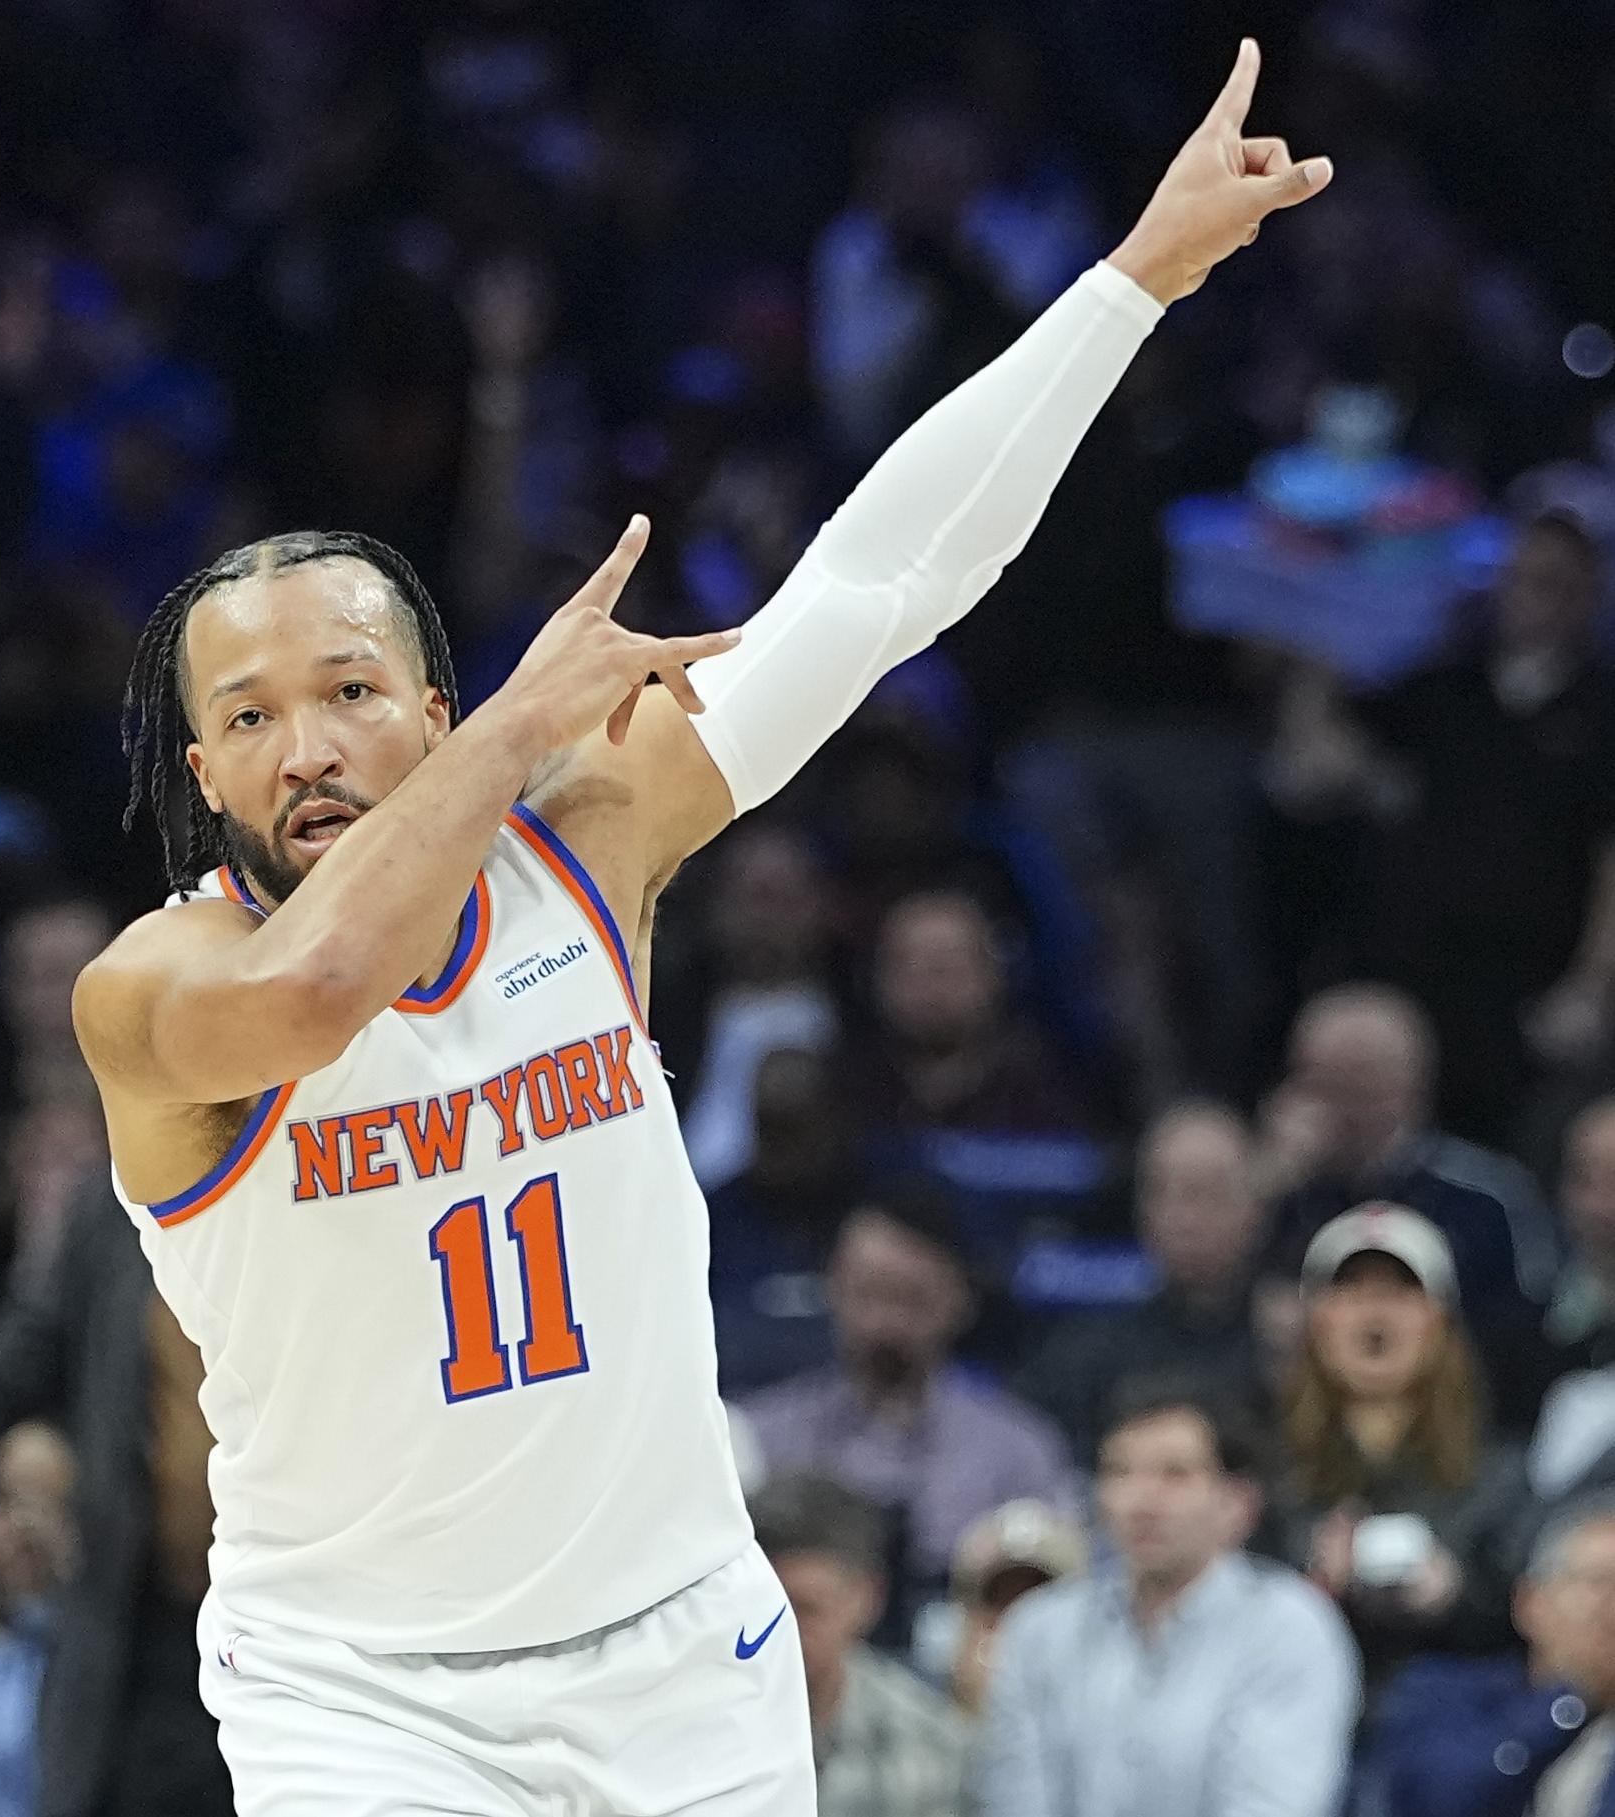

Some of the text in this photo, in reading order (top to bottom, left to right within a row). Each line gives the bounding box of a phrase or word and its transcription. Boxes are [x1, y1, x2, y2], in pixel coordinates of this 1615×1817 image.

[495, 952, 542, 983] experience
[503, 936, 588, 999] abu dhabi
[287, 1023, 645, 1204] NEW YORK
[428, 1172, 590, 1404] 11
